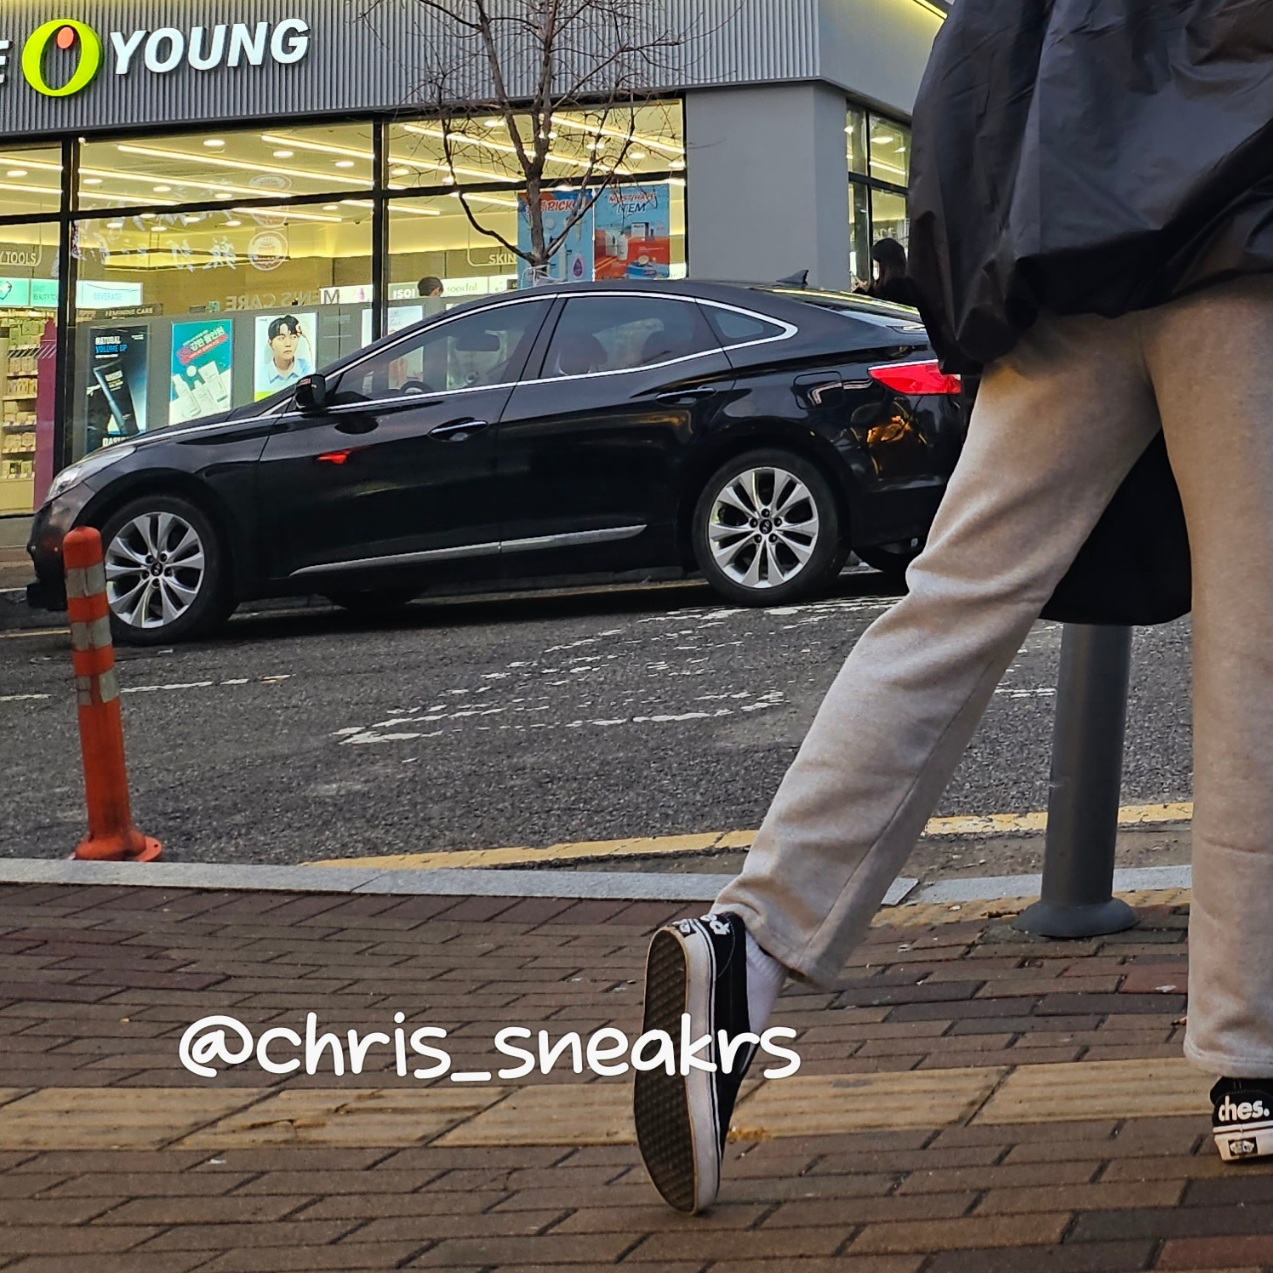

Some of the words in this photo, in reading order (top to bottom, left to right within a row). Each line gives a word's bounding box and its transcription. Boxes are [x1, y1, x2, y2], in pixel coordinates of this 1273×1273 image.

[109, 17, 311, 76] YOUNG
[6, 251, 37, 265] TOOLS
[136, 307, 153, 315] CARE
